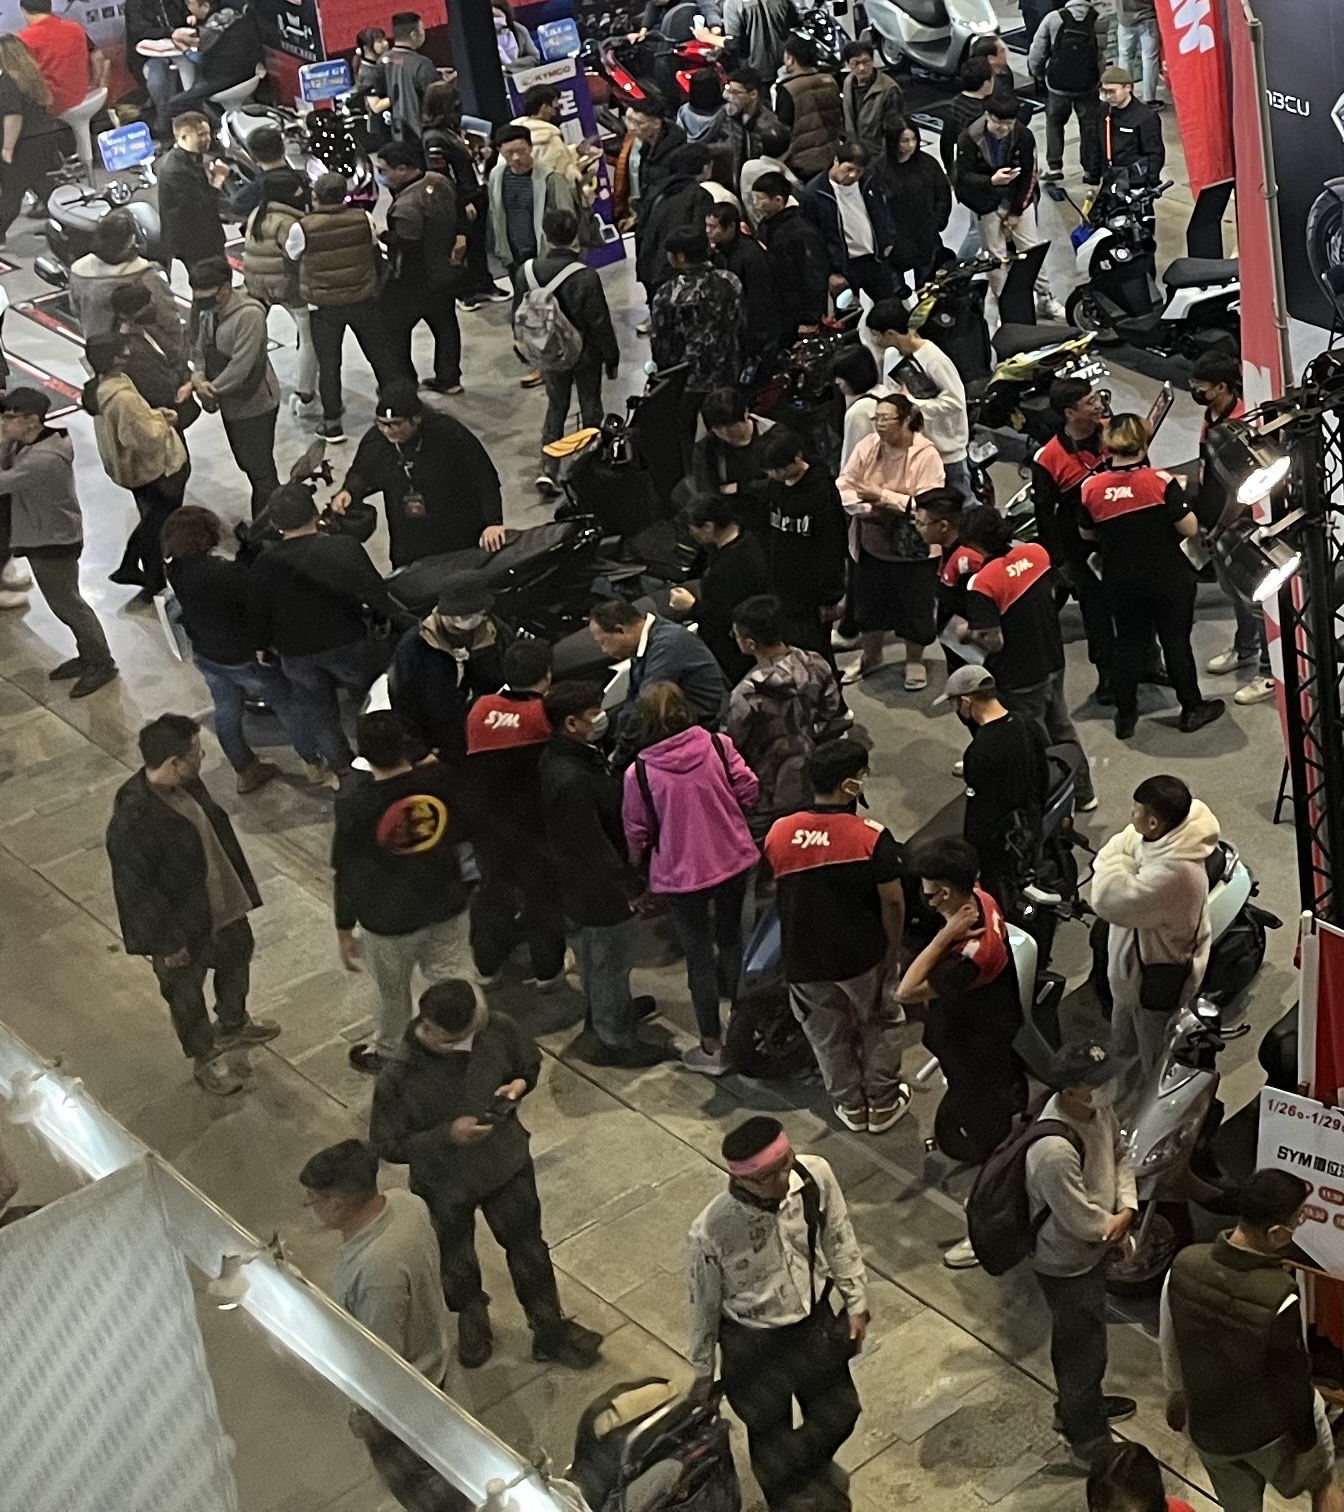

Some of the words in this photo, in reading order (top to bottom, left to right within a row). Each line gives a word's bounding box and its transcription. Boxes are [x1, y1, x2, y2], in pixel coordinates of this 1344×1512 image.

[1103, 485, 1135, 502] SYM
[1005, 557, 1034, 578] SYM
[483, 709, 521, 731] SYM
[791, 829, 831, 849] SYM
